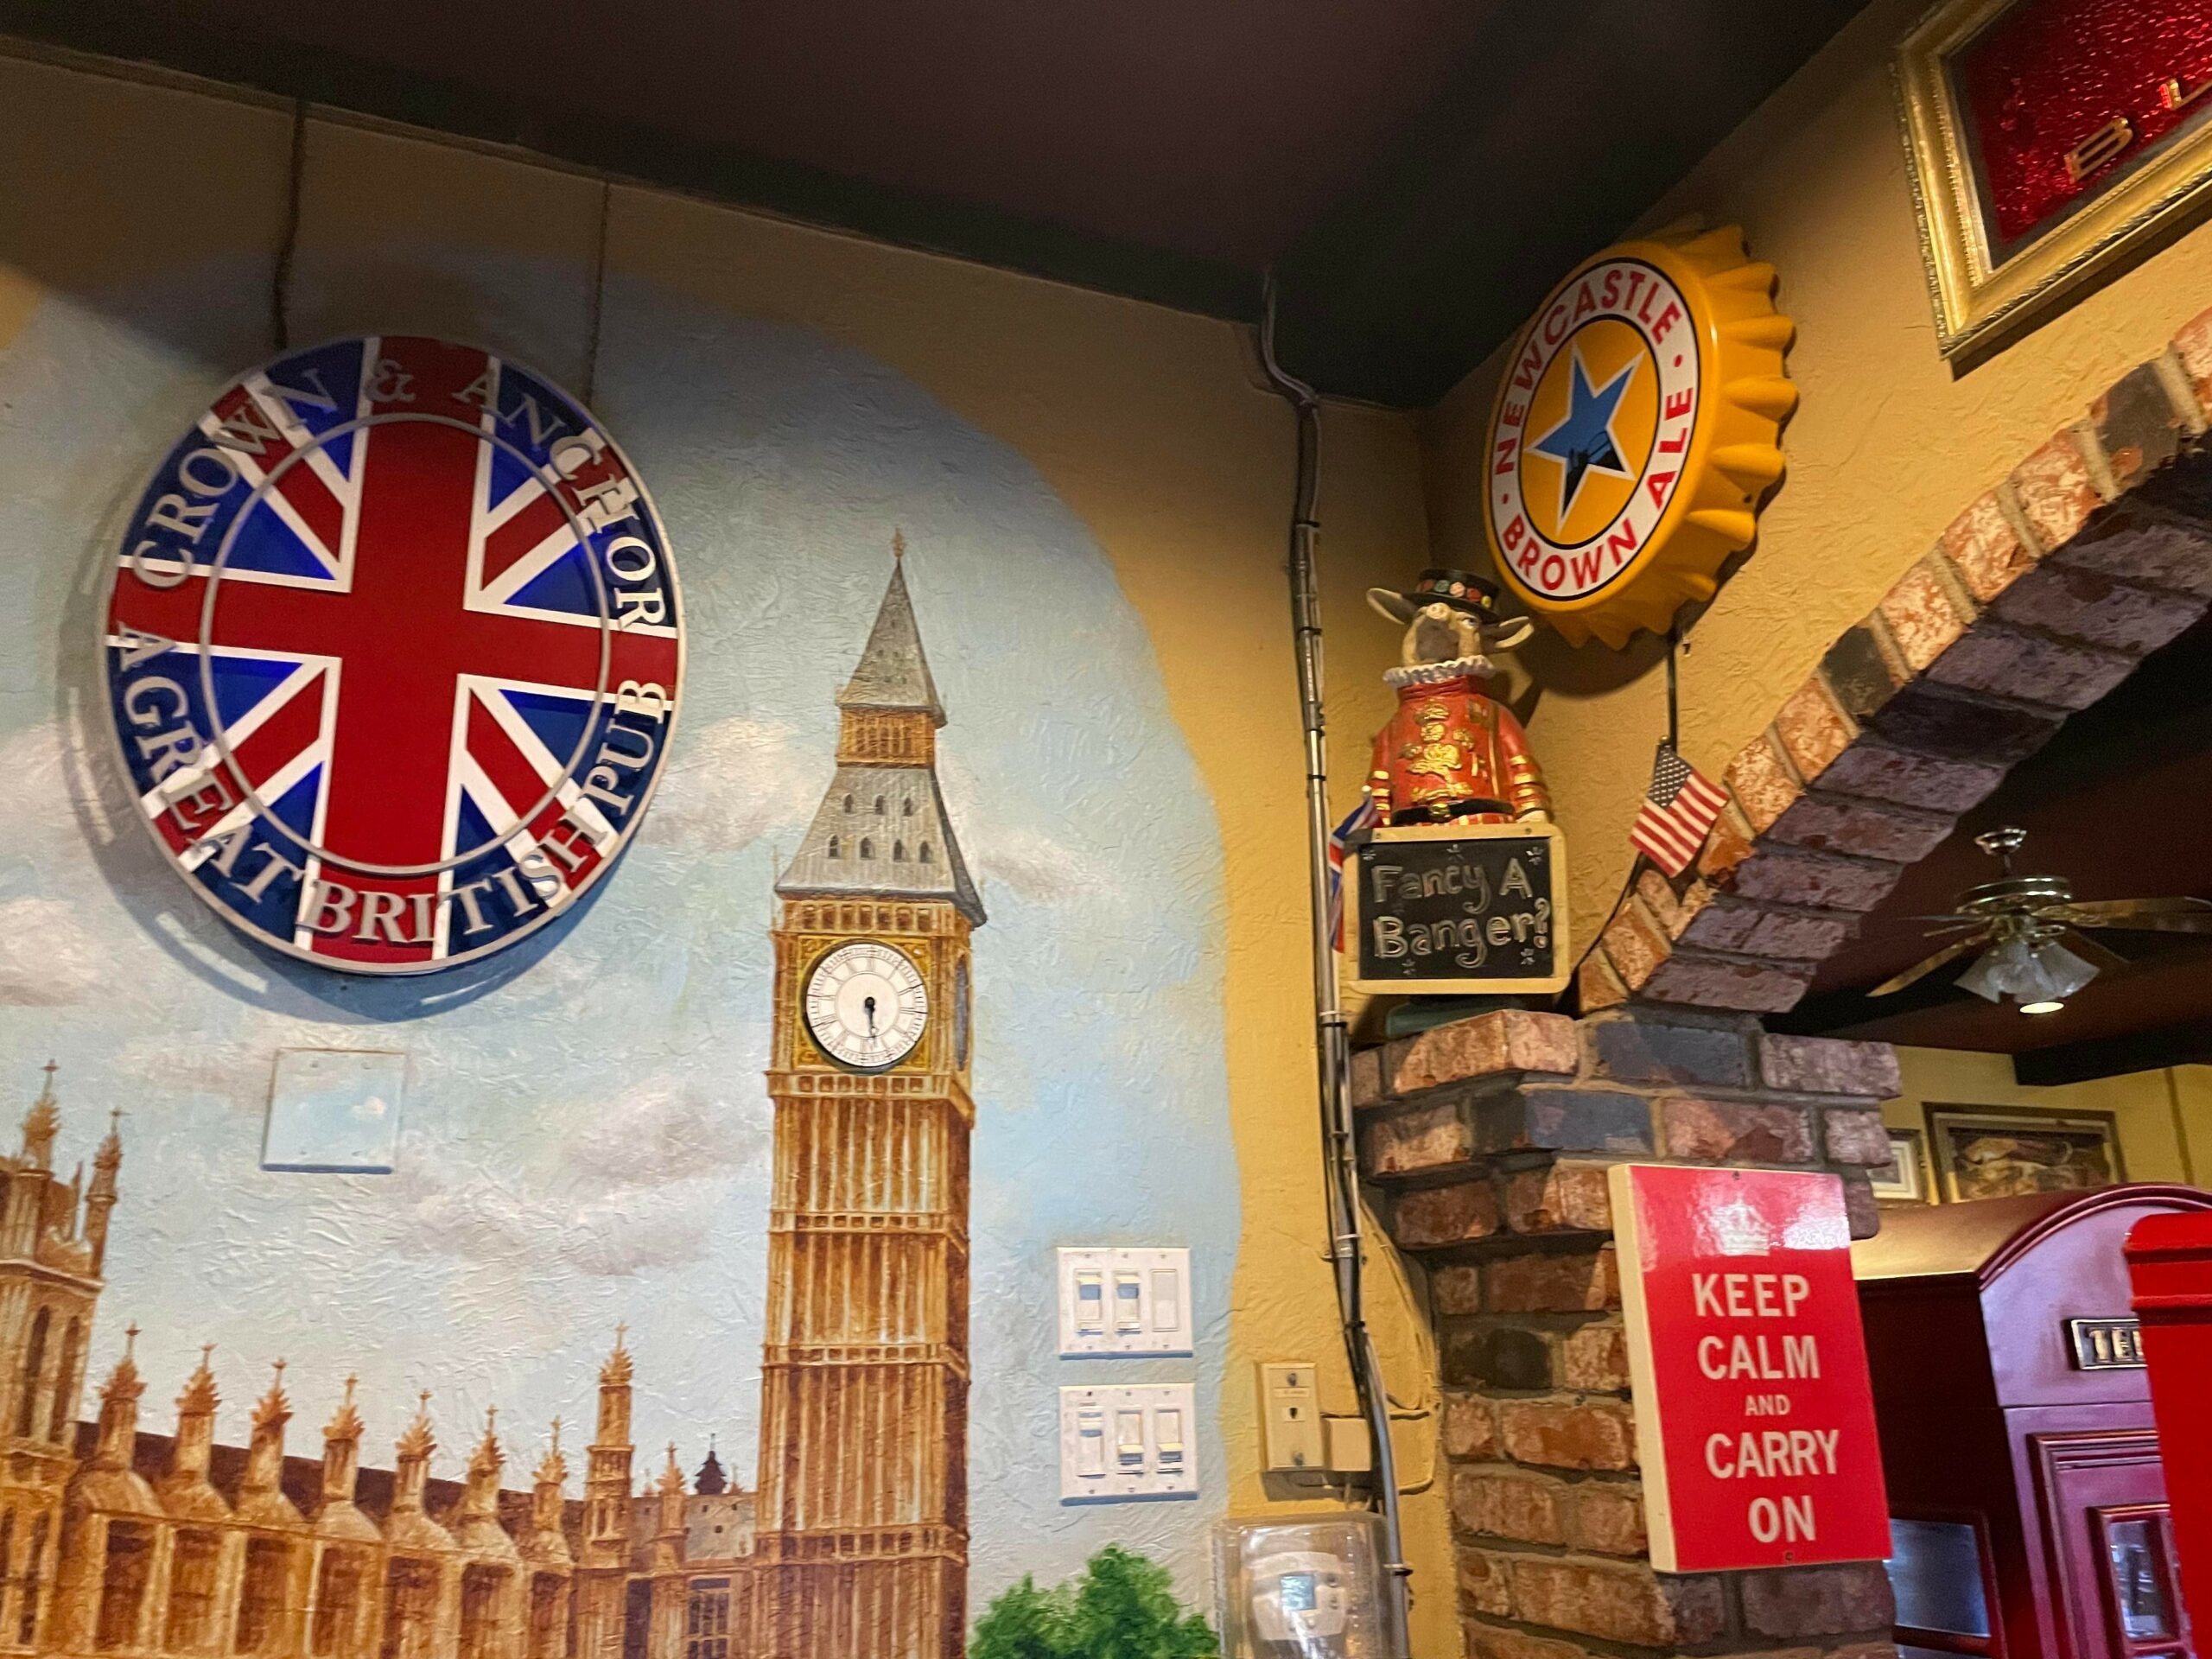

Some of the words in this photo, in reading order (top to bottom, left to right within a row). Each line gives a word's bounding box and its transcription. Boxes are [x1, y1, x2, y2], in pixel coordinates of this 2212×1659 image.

[1494, 268, 1682, 475] NEWCASTLE
[131, 366, 340, 589] CROWN
[367, 358, 416, 404] &
[451, 372, 668, 630] ANCHOR
[1502, 512, 1639, 591] BROWN
[1645, 386, 1694, 510] ALE
[117, 620, 178, 671] A
[591, 679, 668, 817] PUB
[123, 676, 308, 904] GREAT
[296, 810, 611, 944] BRITISH
[1373, 864, 1491, 914] Fancy
[1499, 857, 1534, 899] A
[1373, 897, 1552, 969] Banger?
[1691, 1273, 1810, 1318] KEEP
[1697, 1334, 1820, 1380] CALM
[1745, 1394, 1791, 1416] AND
[1704, 1429, 1840, 1479] CARRY
[1748, 1495, 1817, 1543] ON
